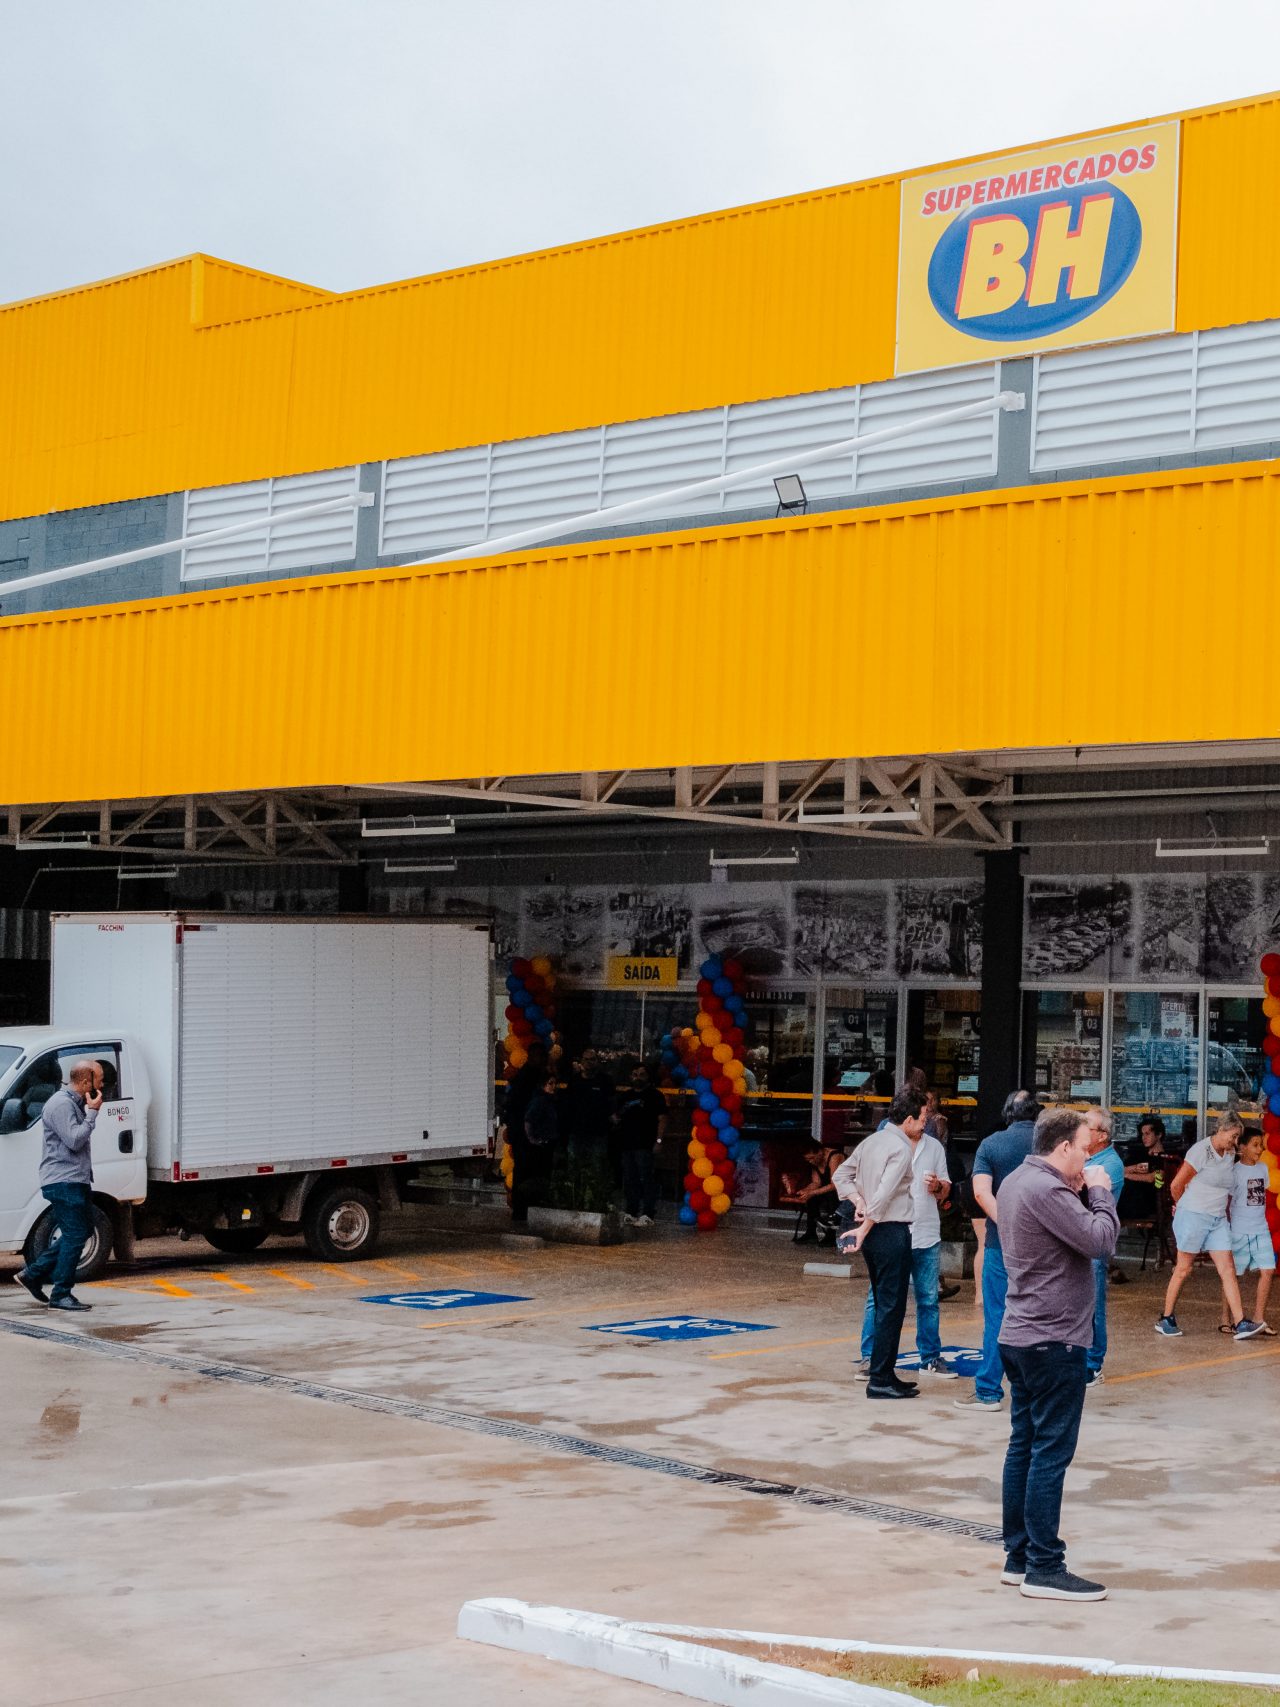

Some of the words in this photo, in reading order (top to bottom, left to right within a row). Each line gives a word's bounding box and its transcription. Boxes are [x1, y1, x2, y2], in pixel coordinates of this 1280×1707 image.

[922, 144, 1156, 216] SUPERMERCADOS
[954, 192, 1115, 320] BH
[624, 962, 660, 980] SAÍDA
[107, 1107, 130, 1116] BONGO
